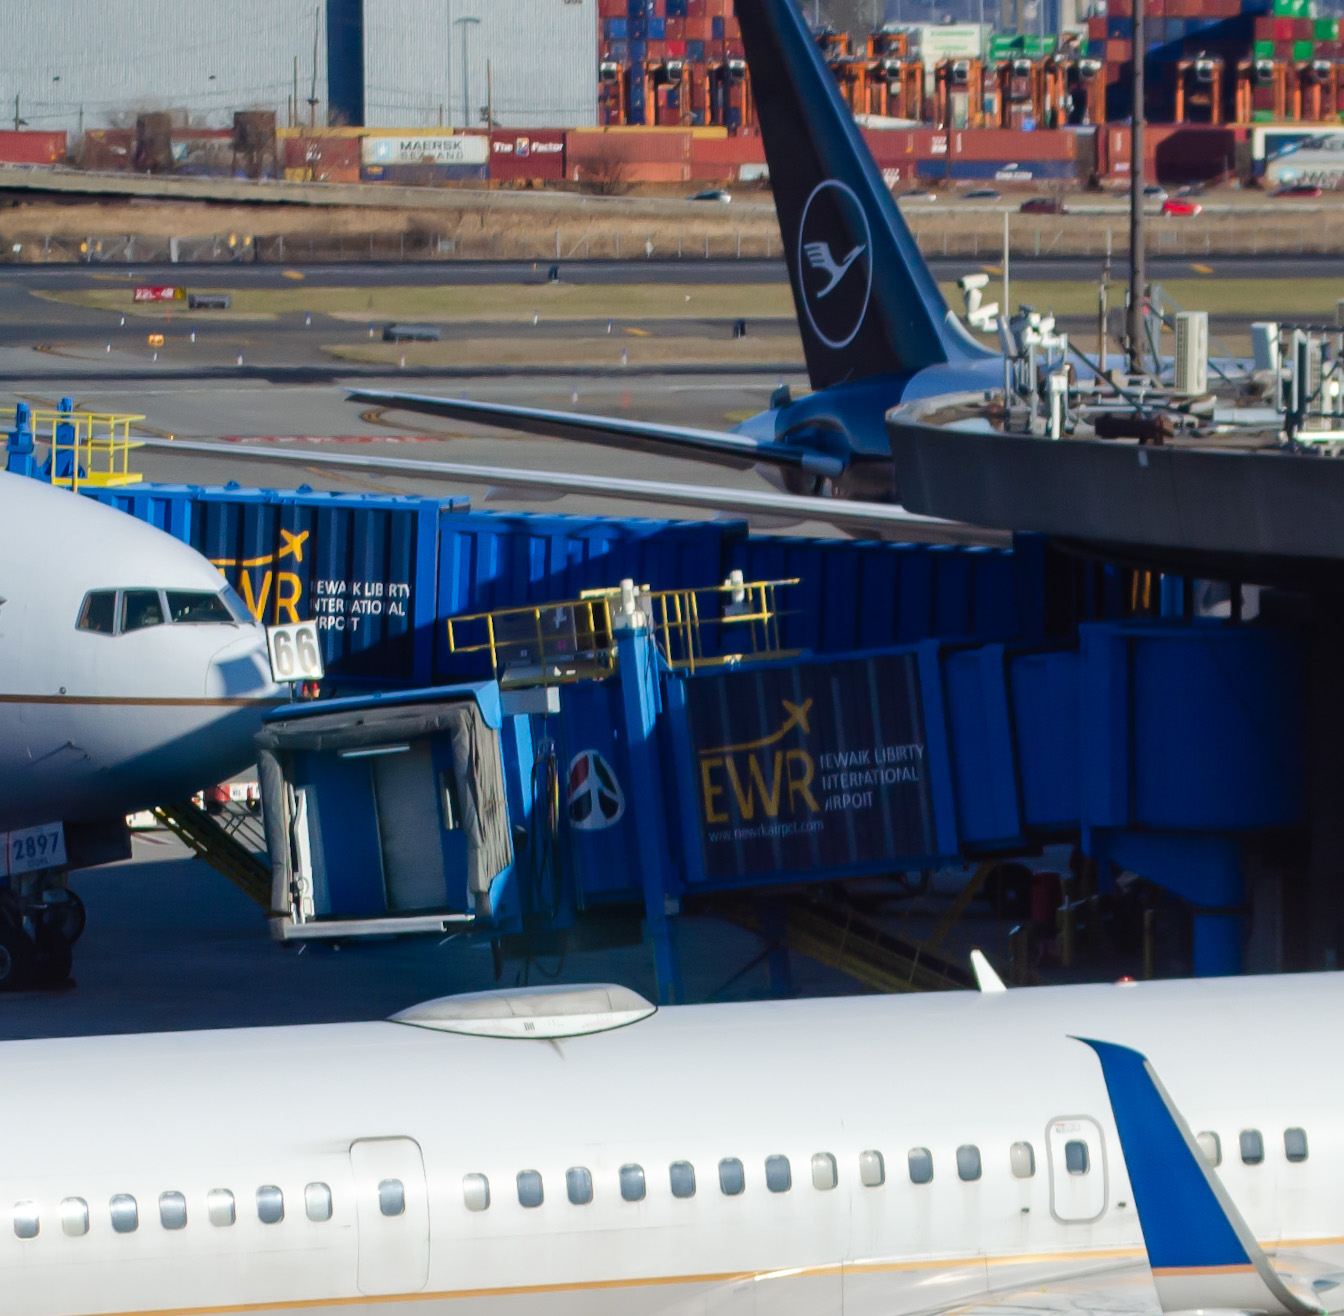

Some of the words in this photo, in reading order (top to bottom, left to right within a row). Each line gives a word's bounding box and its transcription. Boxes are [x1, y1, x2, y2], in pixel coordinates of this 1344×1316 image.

[400, 140, 463, 151] MAERSK
[494, 141, 513, 153] The
[531, 141, 563, 152] Factor
[400, 151, 464, 160] SEAAND
[364, 581, 411, 598] LIBRTY
[273, 627, 318, 676] 66
[700, 750, 821, 824] EWR
[13, 831, 60, 861] 2897
